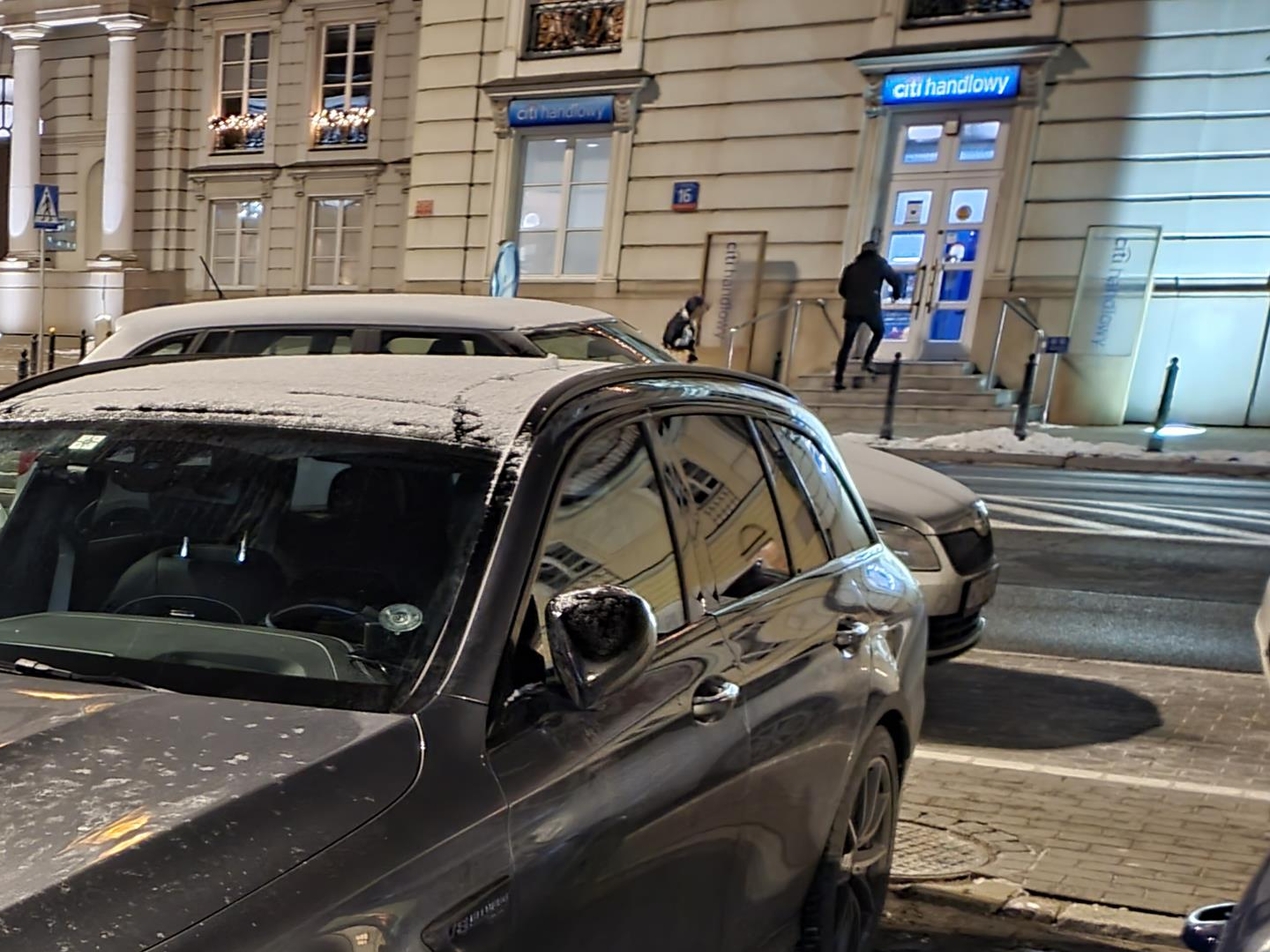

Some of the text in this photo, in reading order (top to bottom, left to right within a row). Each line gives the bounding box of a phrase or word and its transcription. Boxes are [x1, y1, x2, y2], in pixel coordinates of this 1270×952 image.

[892, 74, 1010, 99] citi handlowy
[677, 188, 692, 203] 16
[1111, 237, 1131, 263] citi
